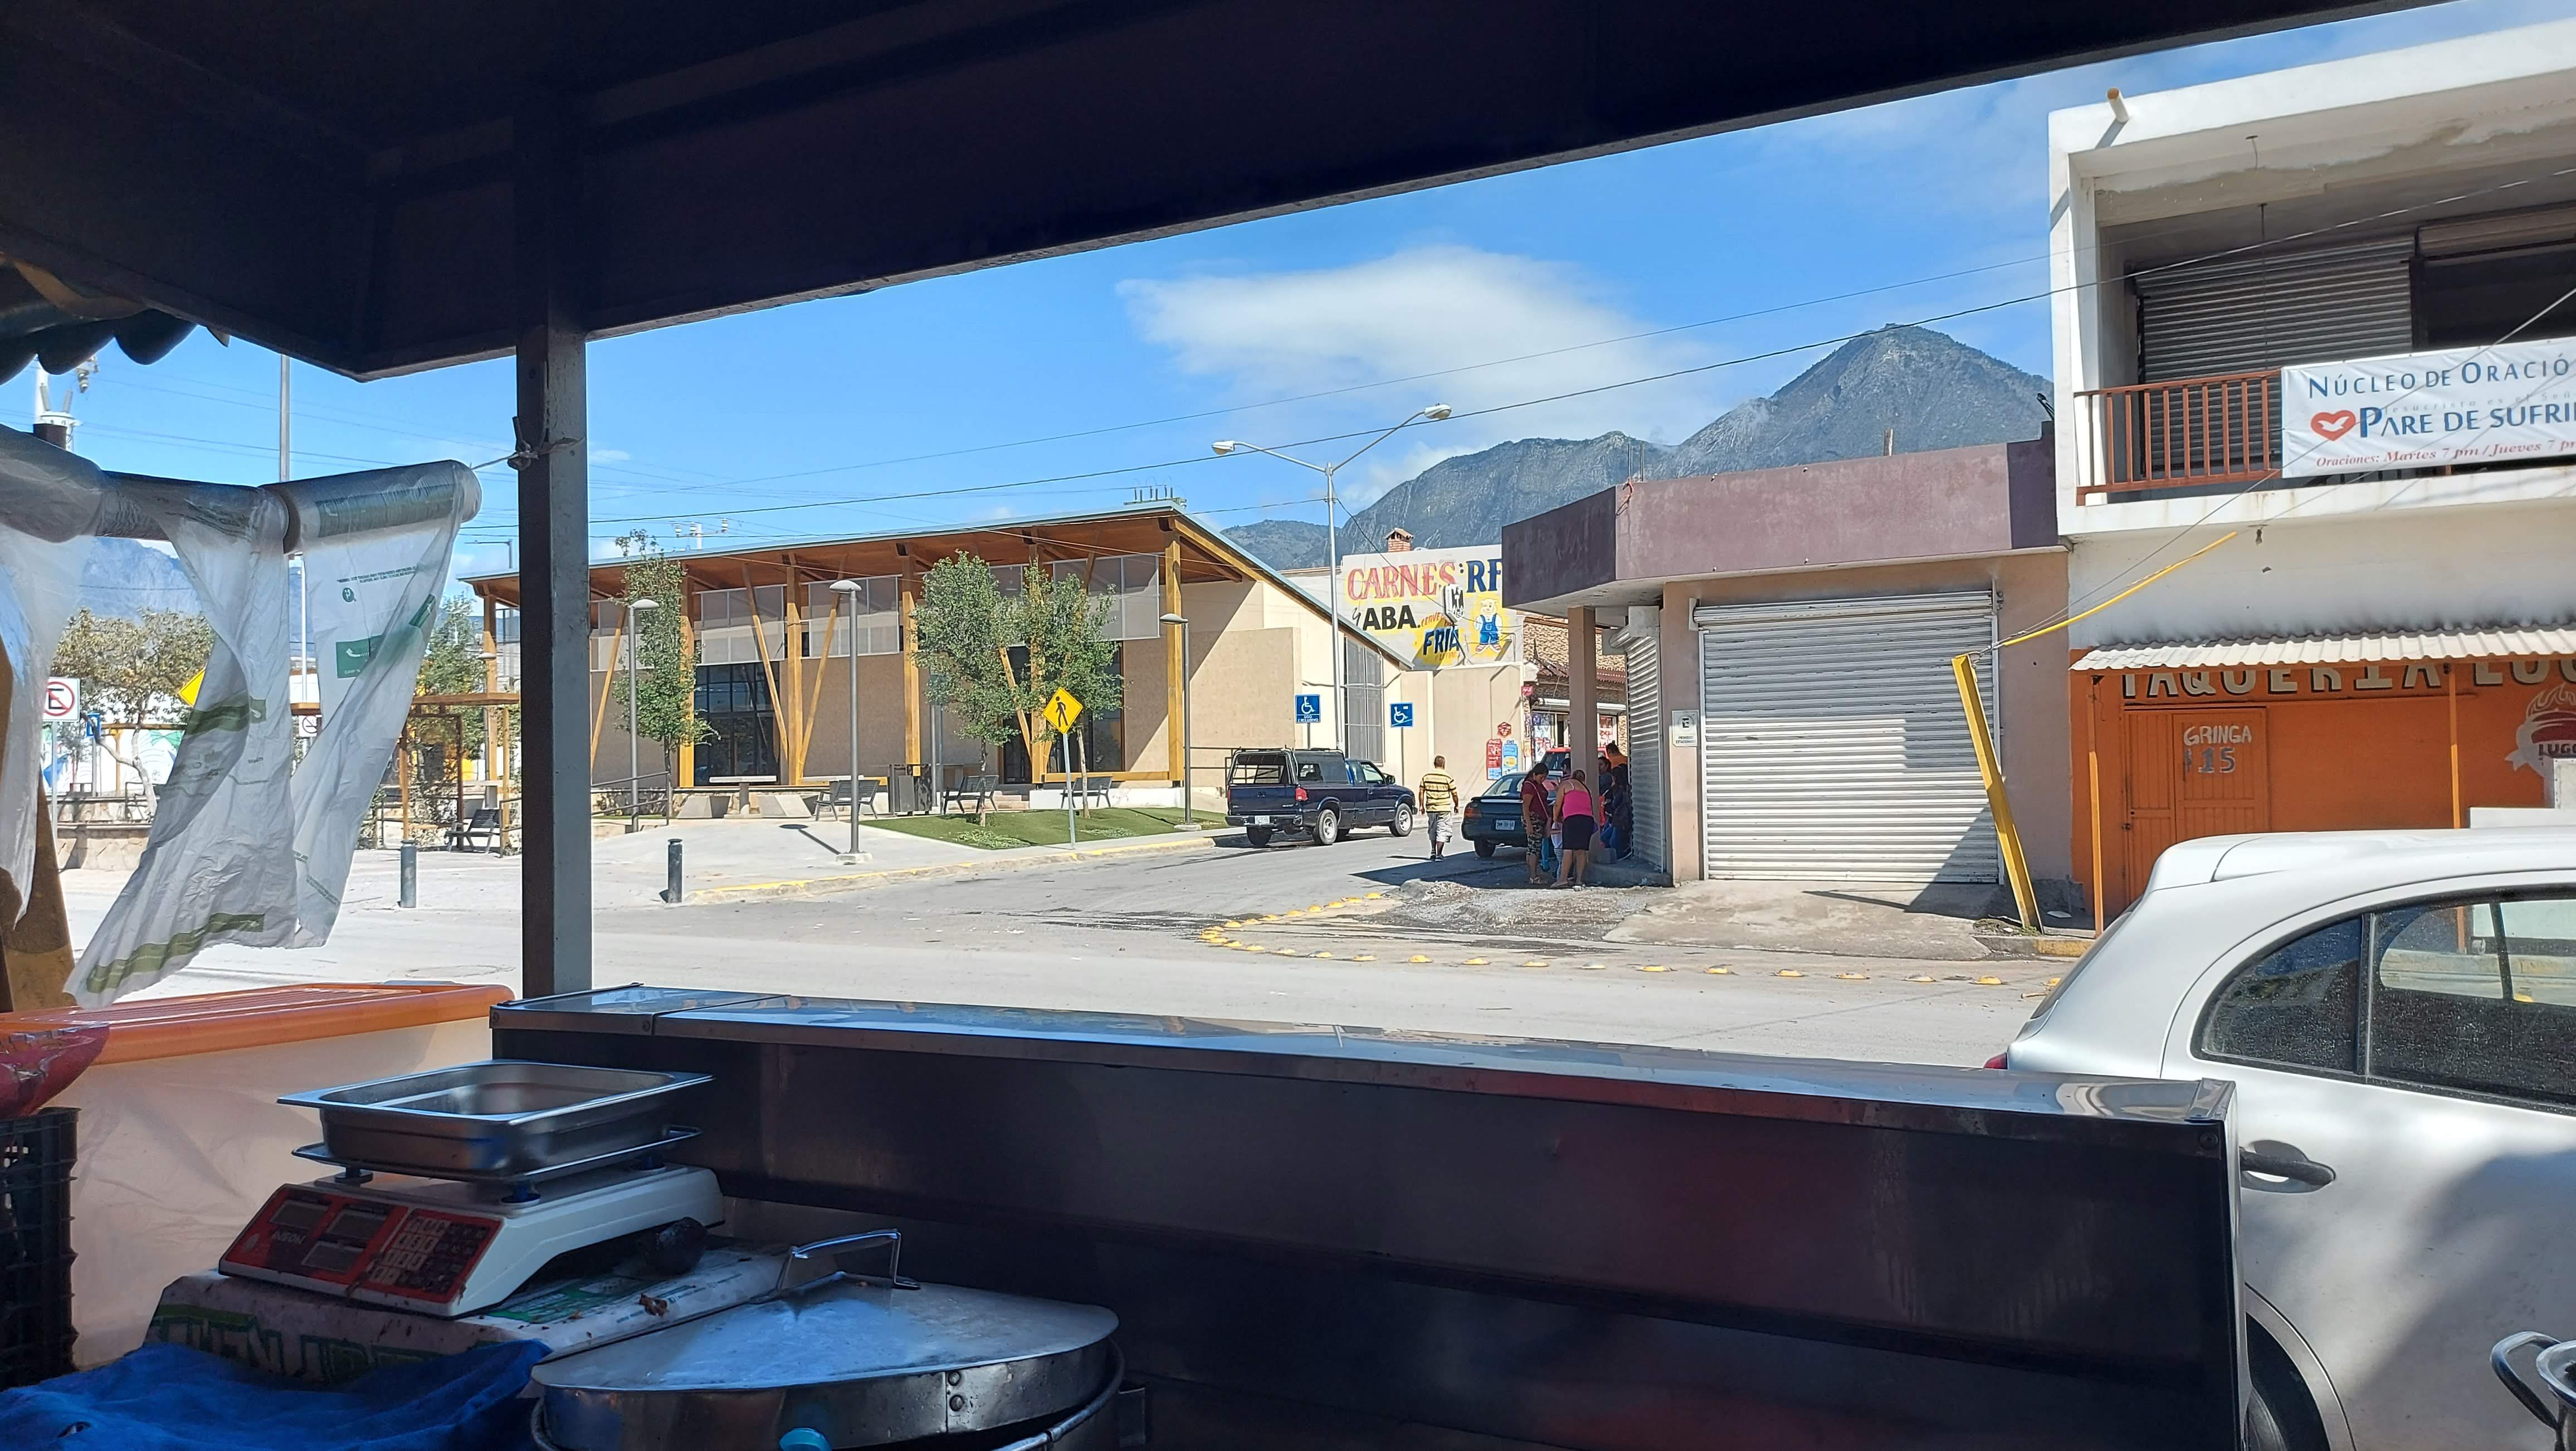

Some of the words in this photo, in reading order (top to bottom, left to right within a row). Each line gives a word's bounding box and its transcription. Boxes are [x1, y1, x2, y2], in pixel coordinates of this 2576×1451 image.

[2309, 373, 2416, 398] NÚCLEO
[2426, 369, 2451, 388] DE
[2359, 406, 2434, 439] PARE
[2443, 410, 2480, 432] DE
[2490, 401, 2576, 428] SUFRI
[2316, 455, 2380, 467] Oraciones:
[2384, 450, 2437, 462] Martes
[2442, 448, 2450, 459] 7
[2452, 448, 2479, 460] pm
[2489, 443, 2542, 457] Jueves
[2548, 440, 2555, 449] 7
[1423, 628, 1460, 656] FRIA
[2183, 725, 2252, 746] GRINGA
